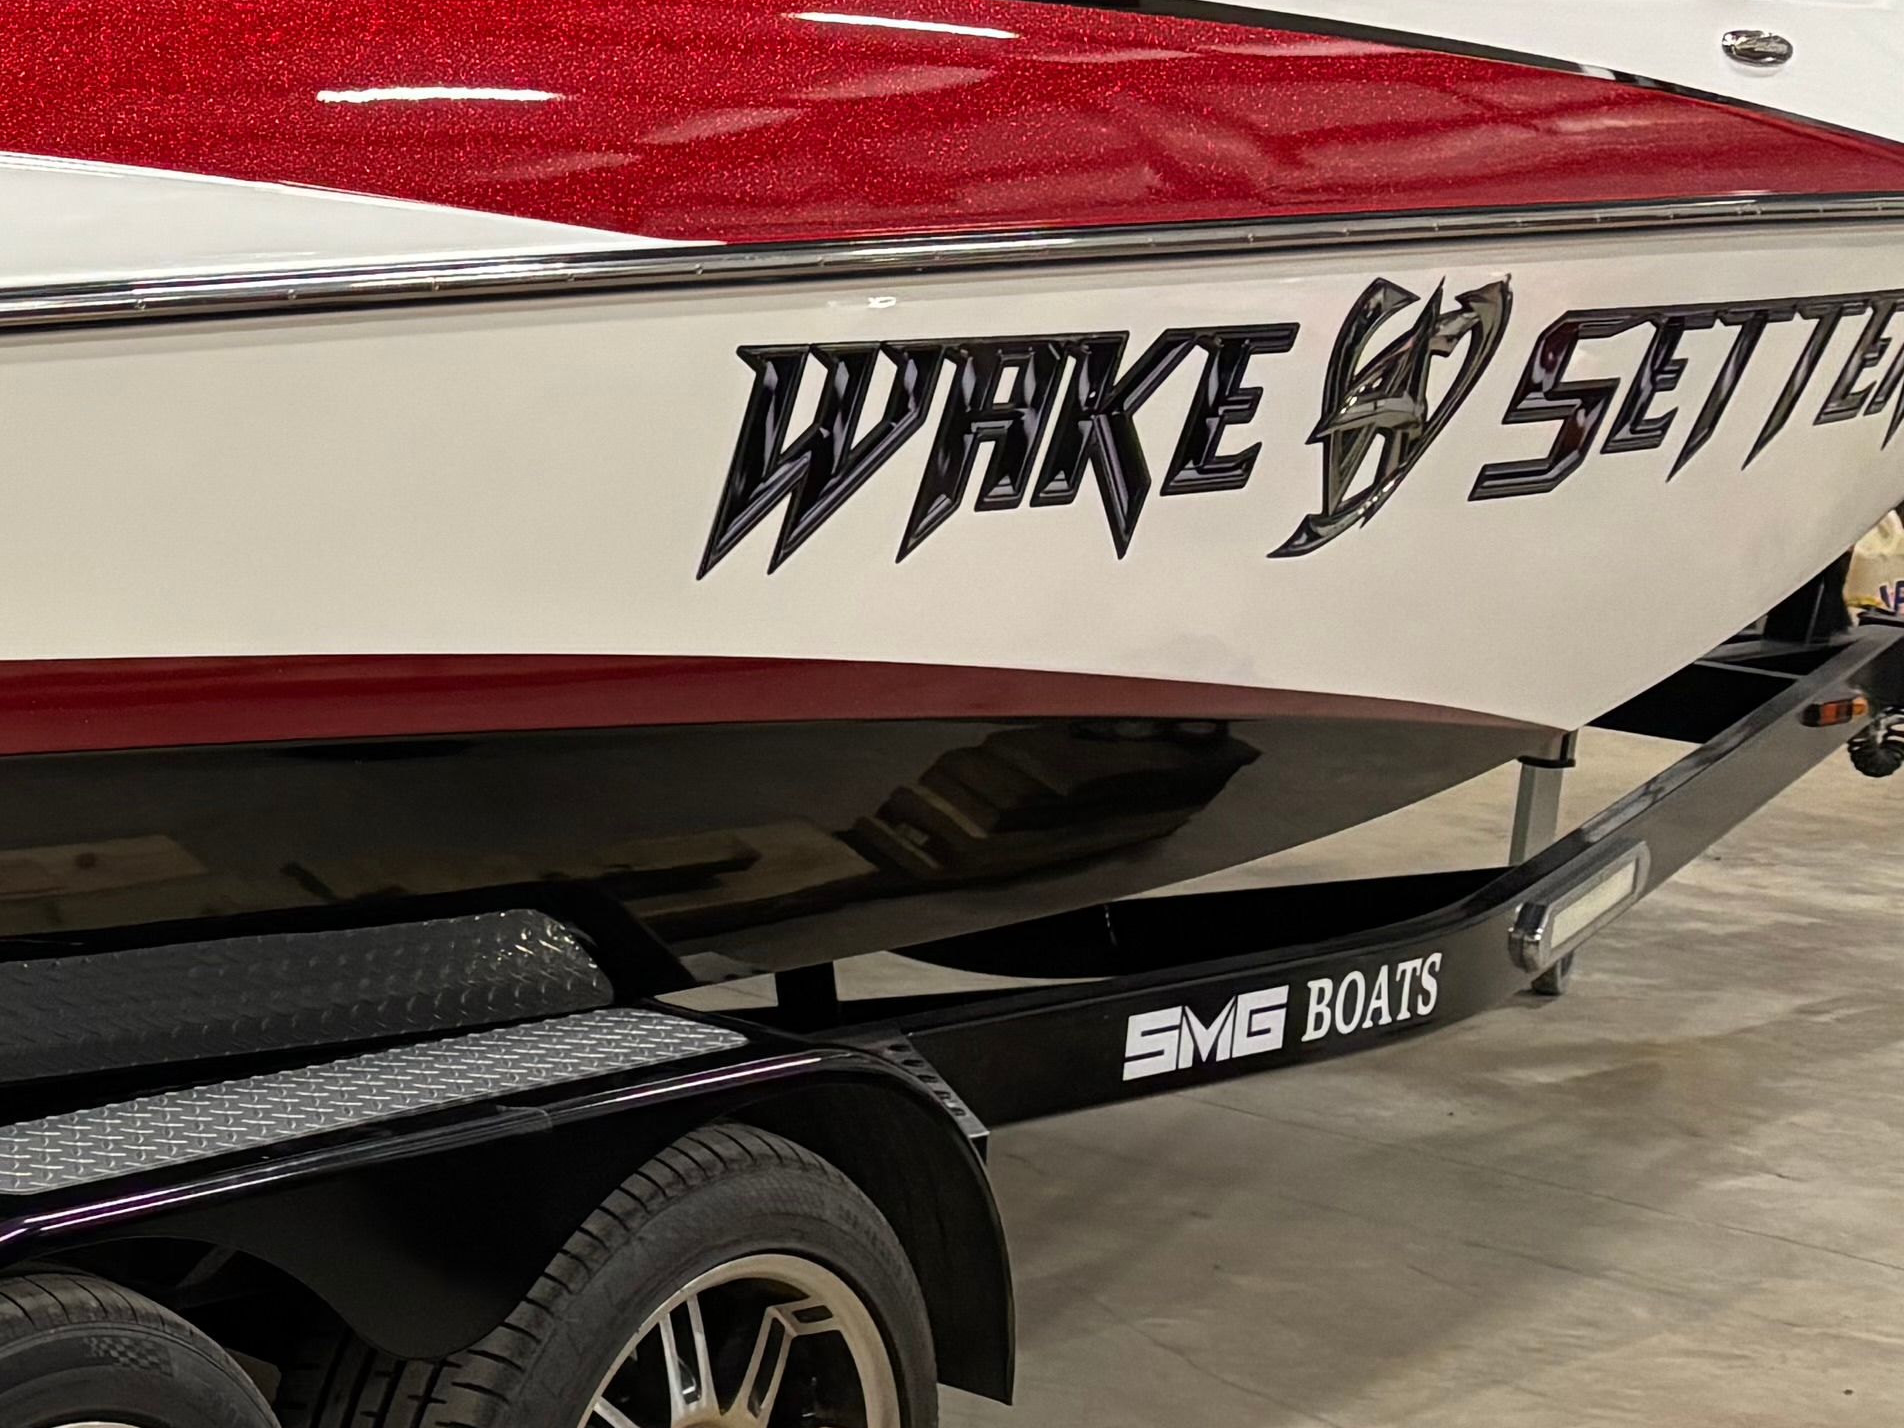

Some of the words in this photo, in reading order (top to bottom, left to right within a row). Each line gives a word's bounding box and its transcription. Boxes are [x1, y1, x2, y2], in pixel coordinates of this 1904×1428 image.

[696, 322, 1300, 580] WAKE
[1122, 983, 1289, 1082] SMG
[1300, 951, 1443, 1043] BOATS
